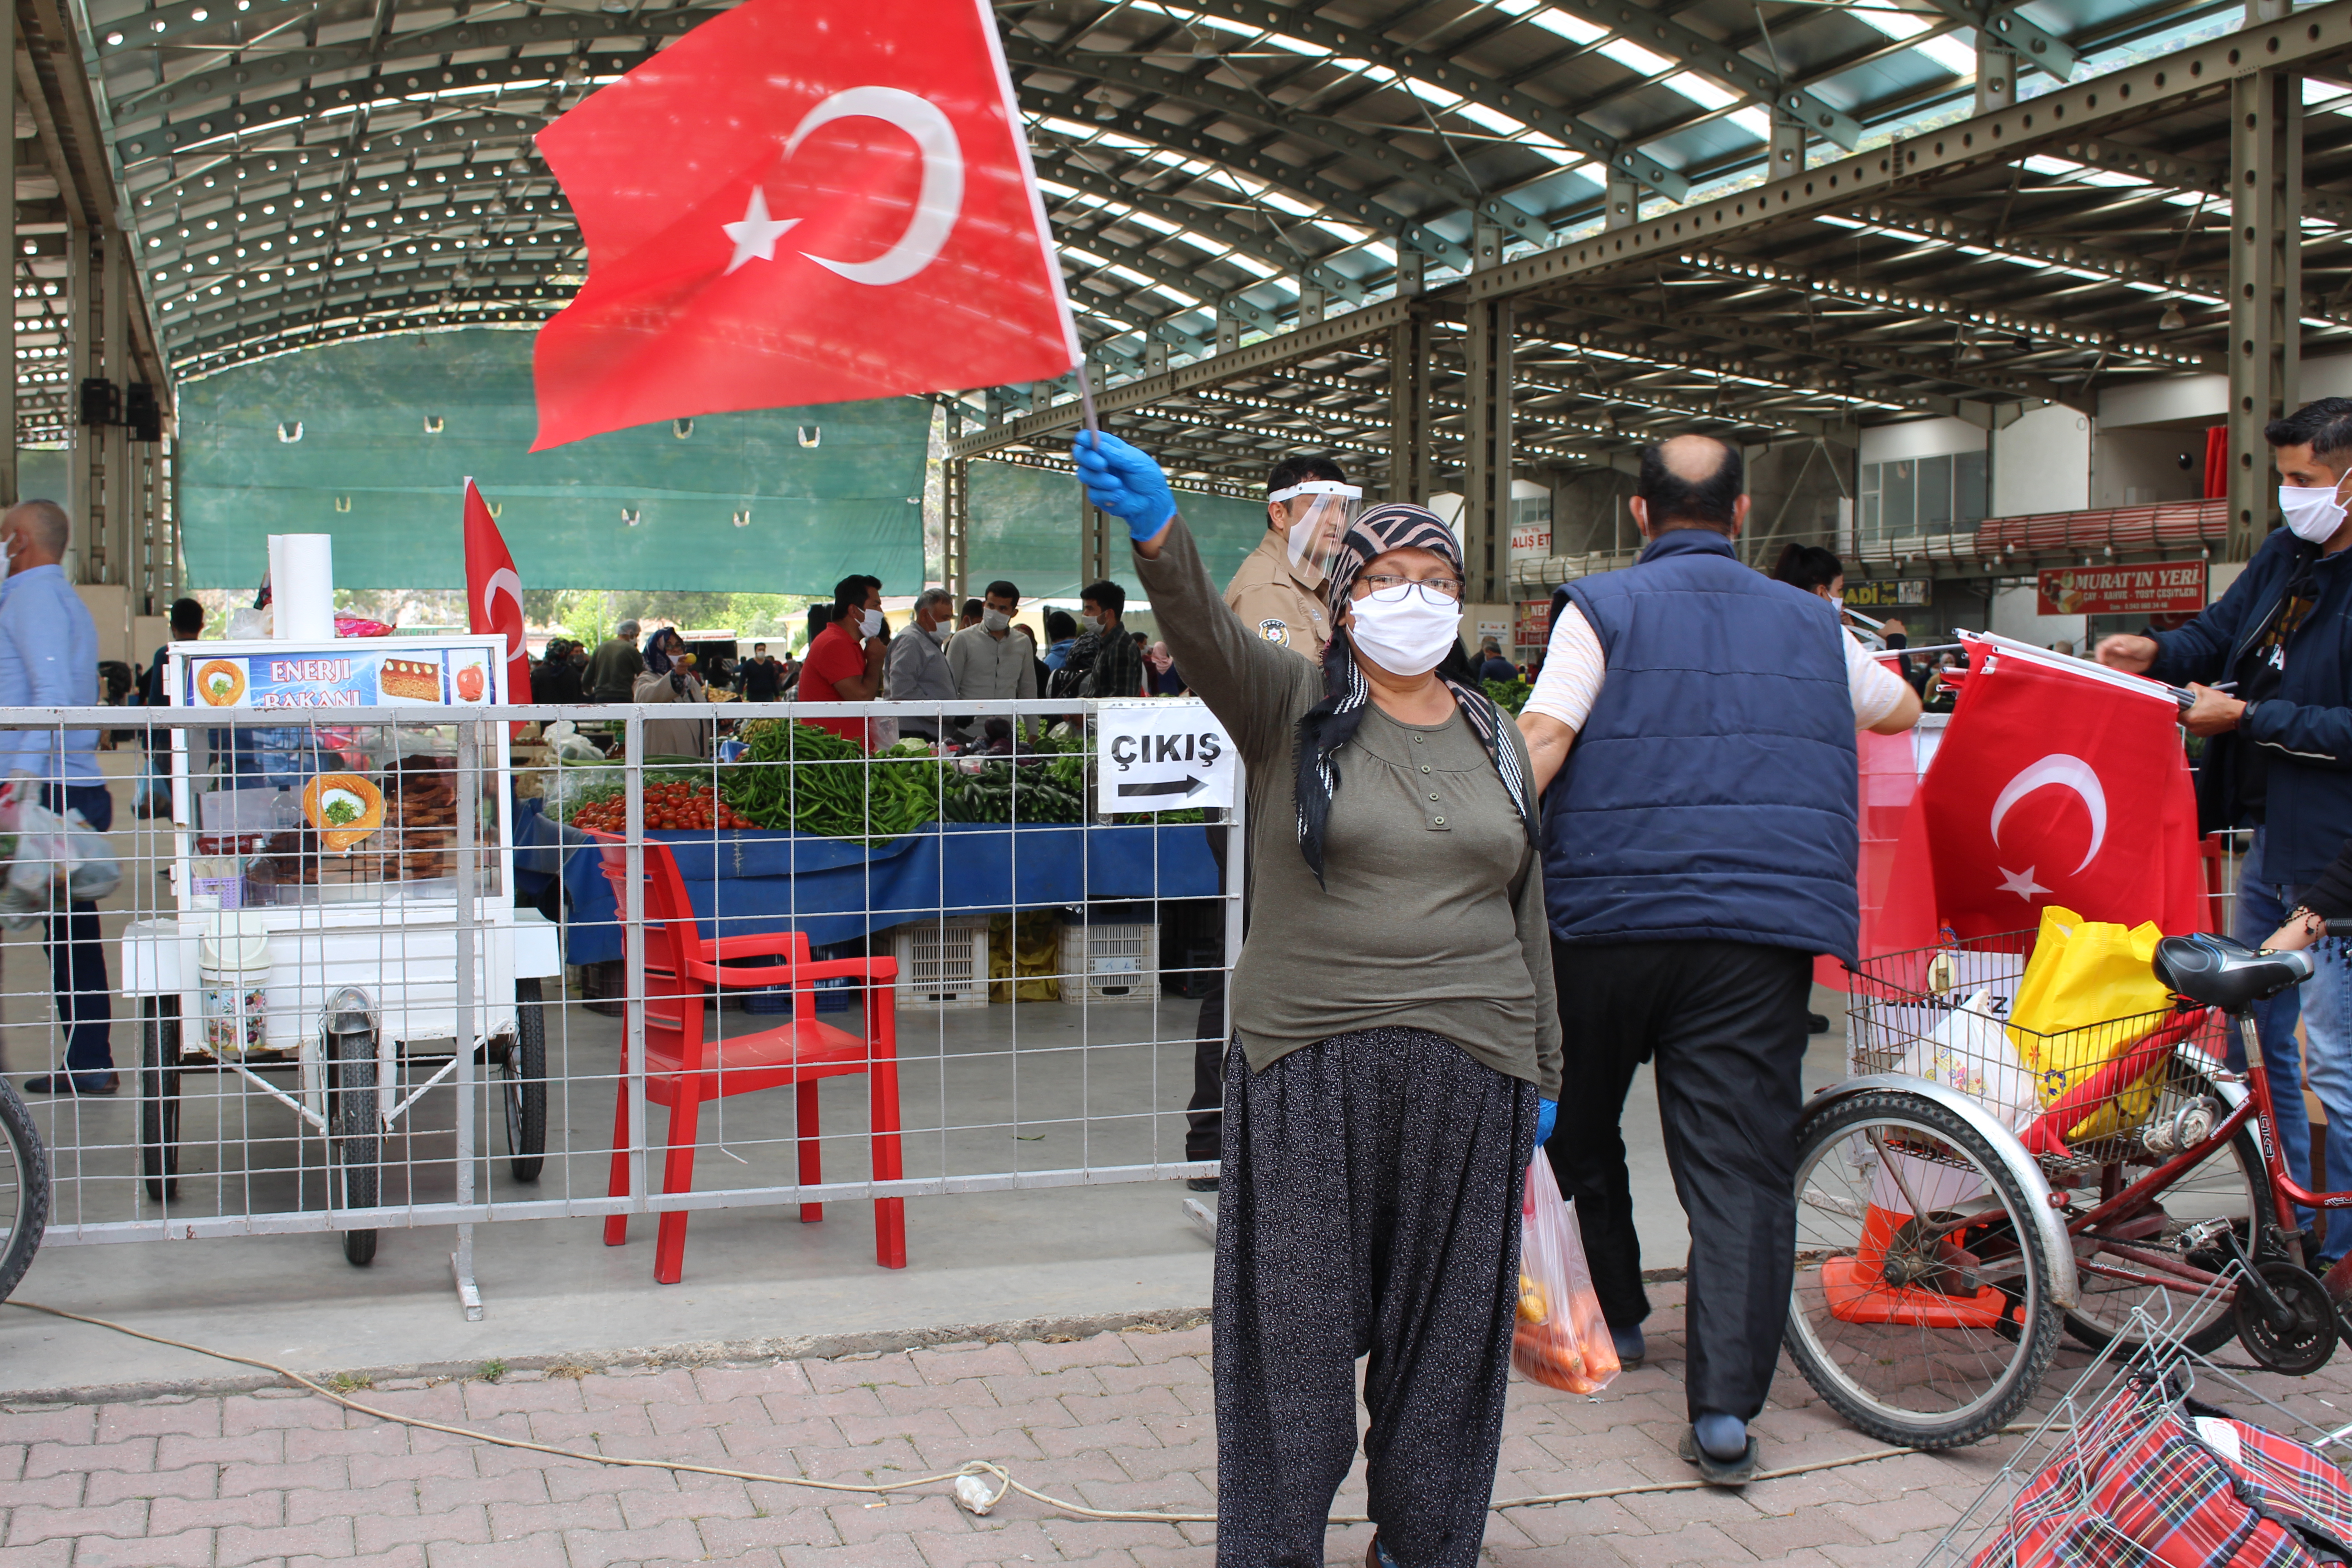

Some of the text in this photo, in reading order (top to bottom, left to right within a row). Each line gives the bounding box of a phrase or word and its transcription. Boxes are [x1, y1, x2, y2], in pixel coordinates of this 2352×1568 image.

[2159, 564, 2200, 586] YERİ
[2083, 592, 2097, 603] ÇAY
[2103, 591, 2128, 600] KAHVE
[2135, 589, 2155, 599] TOST
[1531, 604, 1550, 616] NEF
[1111, 733, 1222, 771] ÇIKIŞ
